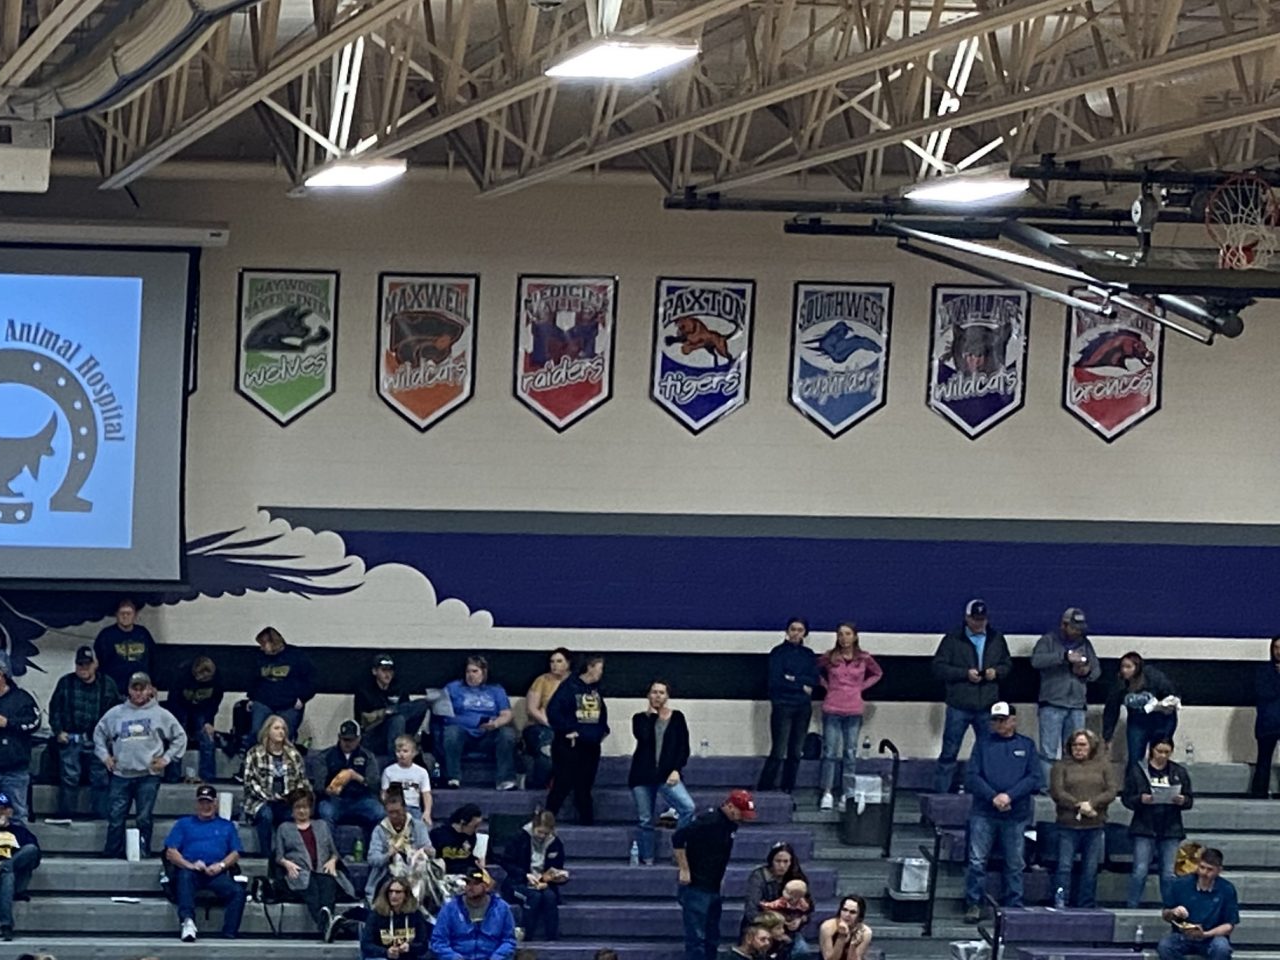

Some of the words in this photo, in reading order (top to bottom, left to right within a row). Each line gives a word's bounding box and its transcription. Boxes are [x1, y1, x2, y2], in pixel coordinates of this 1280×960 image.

[384, 282, 470, 325] MAXWELL
[663, 288, 747, 329] PAXTON
[798, 291, 885, 332] SOUTHWEST
[4, 318, 83, 364] Animal
[75, 353, 126, 442] Hospital
[243, 352, 328, 389] wolves
[521, 355, 605, 394] raiders
[658, 369, 742, 404] tigers
